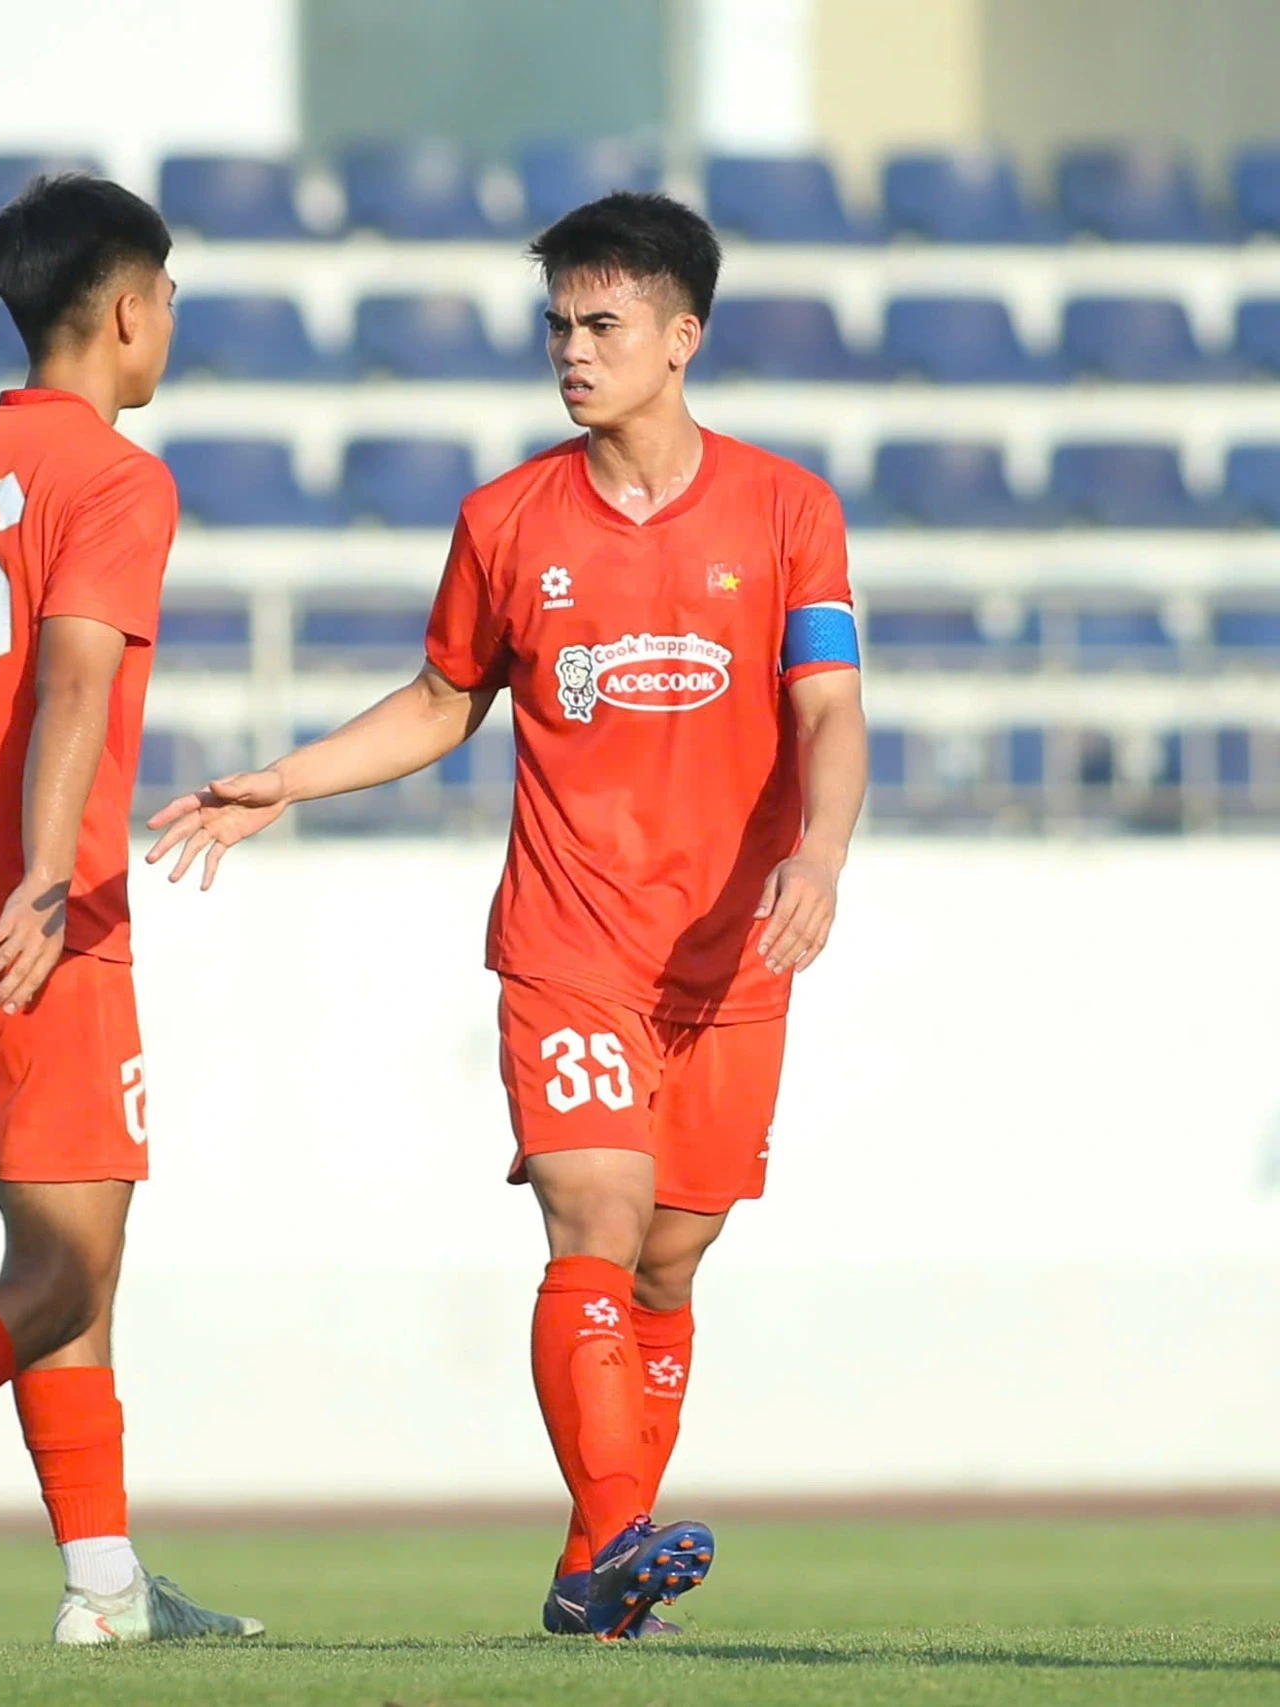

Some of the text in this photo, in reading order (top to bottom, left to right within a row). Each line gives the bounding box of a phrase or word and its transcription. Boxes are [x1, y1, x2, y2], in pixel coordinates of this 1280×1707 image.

[593, 637, 729, 664] Cook happiness
[540, 1026, 634, 1114] 35
